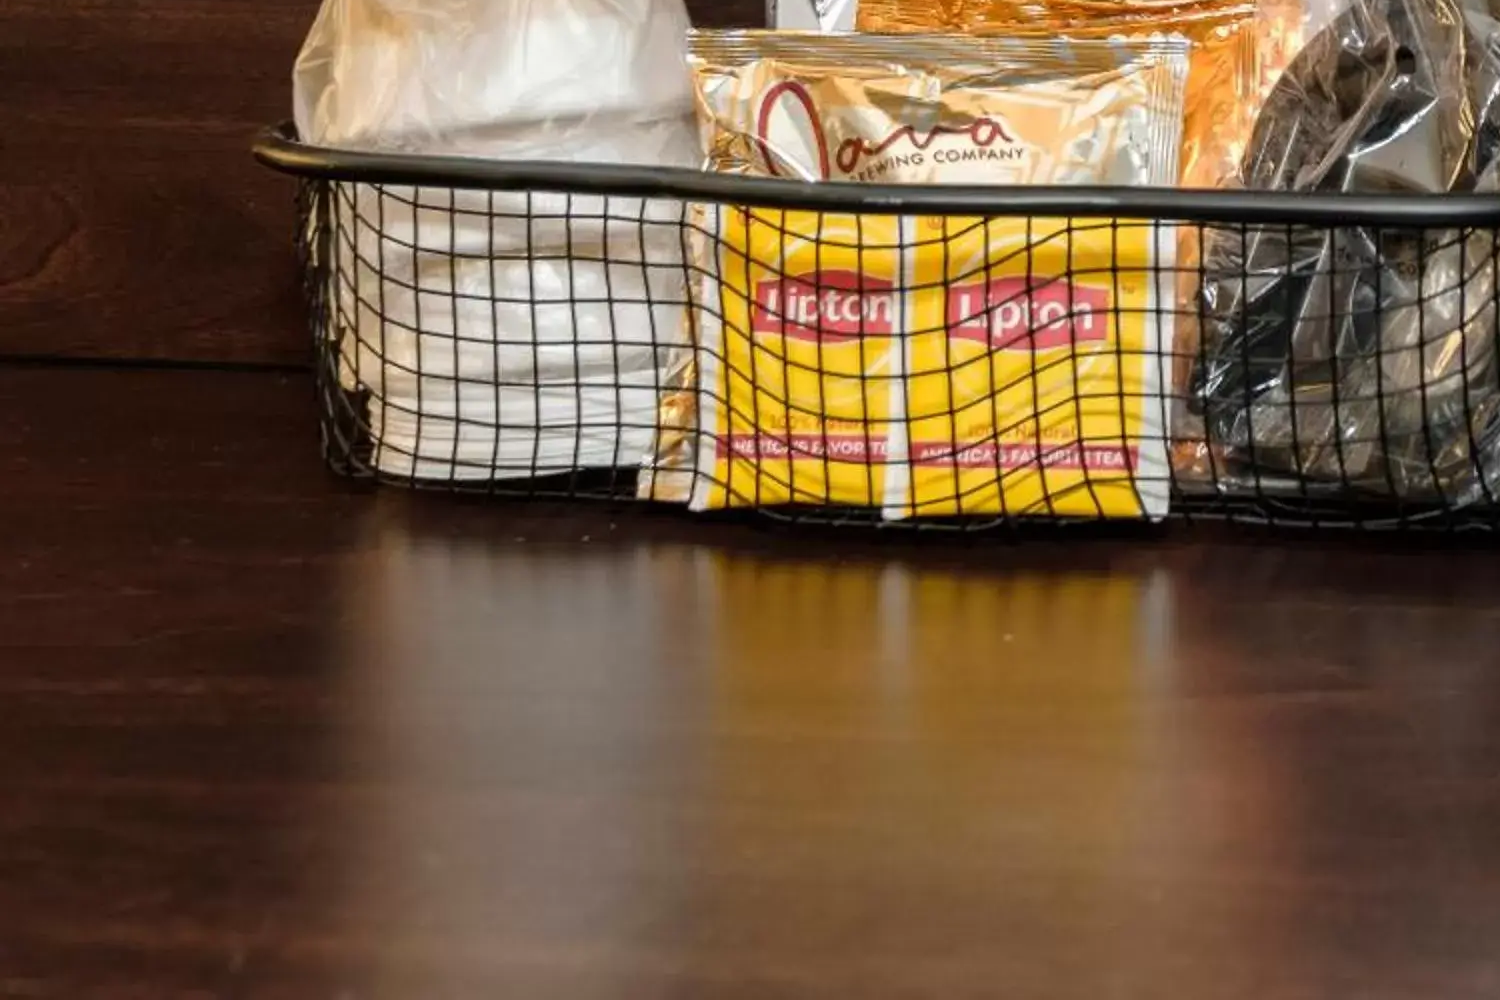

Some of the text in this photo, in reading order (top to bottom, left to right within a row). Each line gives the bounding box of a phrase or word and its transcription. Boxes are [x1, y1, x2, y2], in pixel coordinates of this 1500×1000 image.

[933, 147, 1025, 164] COMPANY
[765, 287, 893, 329] Lipton
[958, 293, 1094, 340] Lipton
[1093, 451, 1125, 466] TEA
